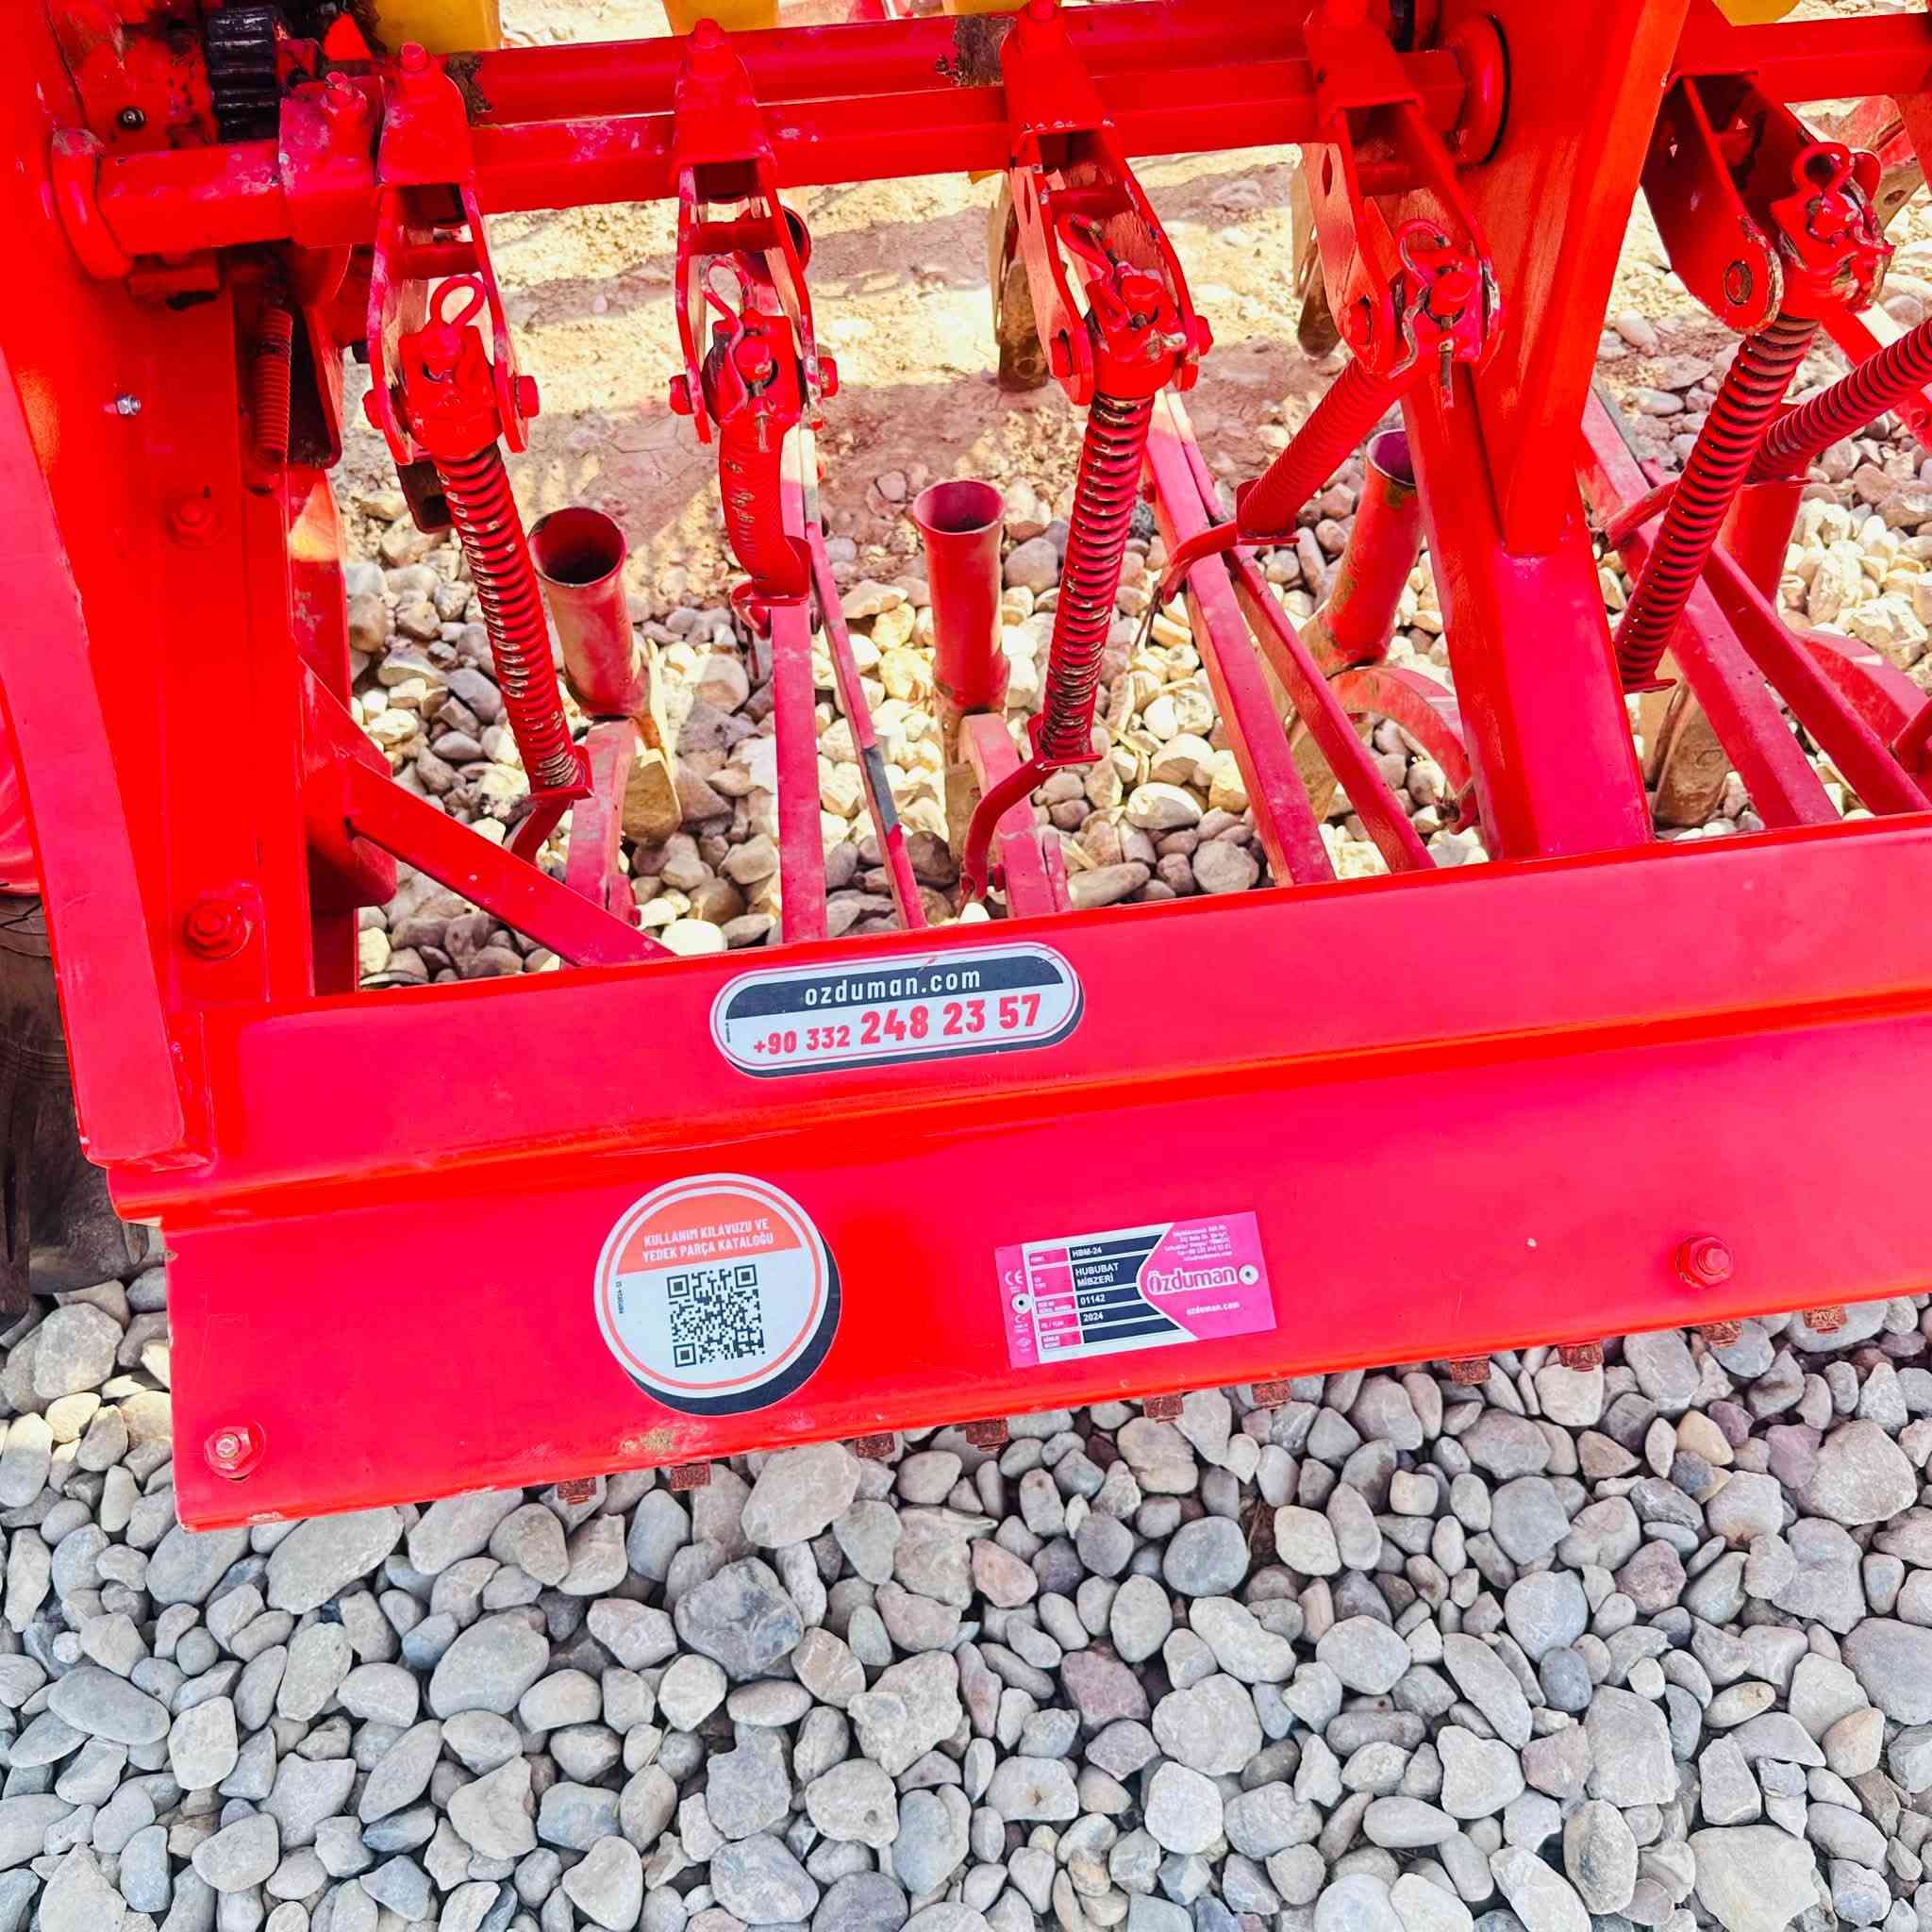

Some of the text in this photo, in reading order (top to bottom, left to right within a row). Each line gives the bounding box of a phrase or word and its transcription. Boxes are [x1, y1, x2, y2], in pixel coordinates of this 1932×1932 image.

[804, 969, 981, 1007] ozduman.com
[753, 1030, 797, 1056] +90
[806, 1025, 851, 1051] 332
[859, 1006, 929, 1045] 248
[942, 1000, 987, 1036] 23
[998, 993, 1042, 1030] 57
[643, 1218, 770, 1247] KULLANIM KILAVUZU VE
[641, 1232, 774, 1263] YEDEK PARÇA KATALOĞU
[1074, 1262, 1120, 1276] HUBUBAT
[1076, 1274, 1114, 1288] MİBZERİ
[1080, 1293, 1106, 1306] 01142
[1083, 1310, 1104, 1323] 2024
